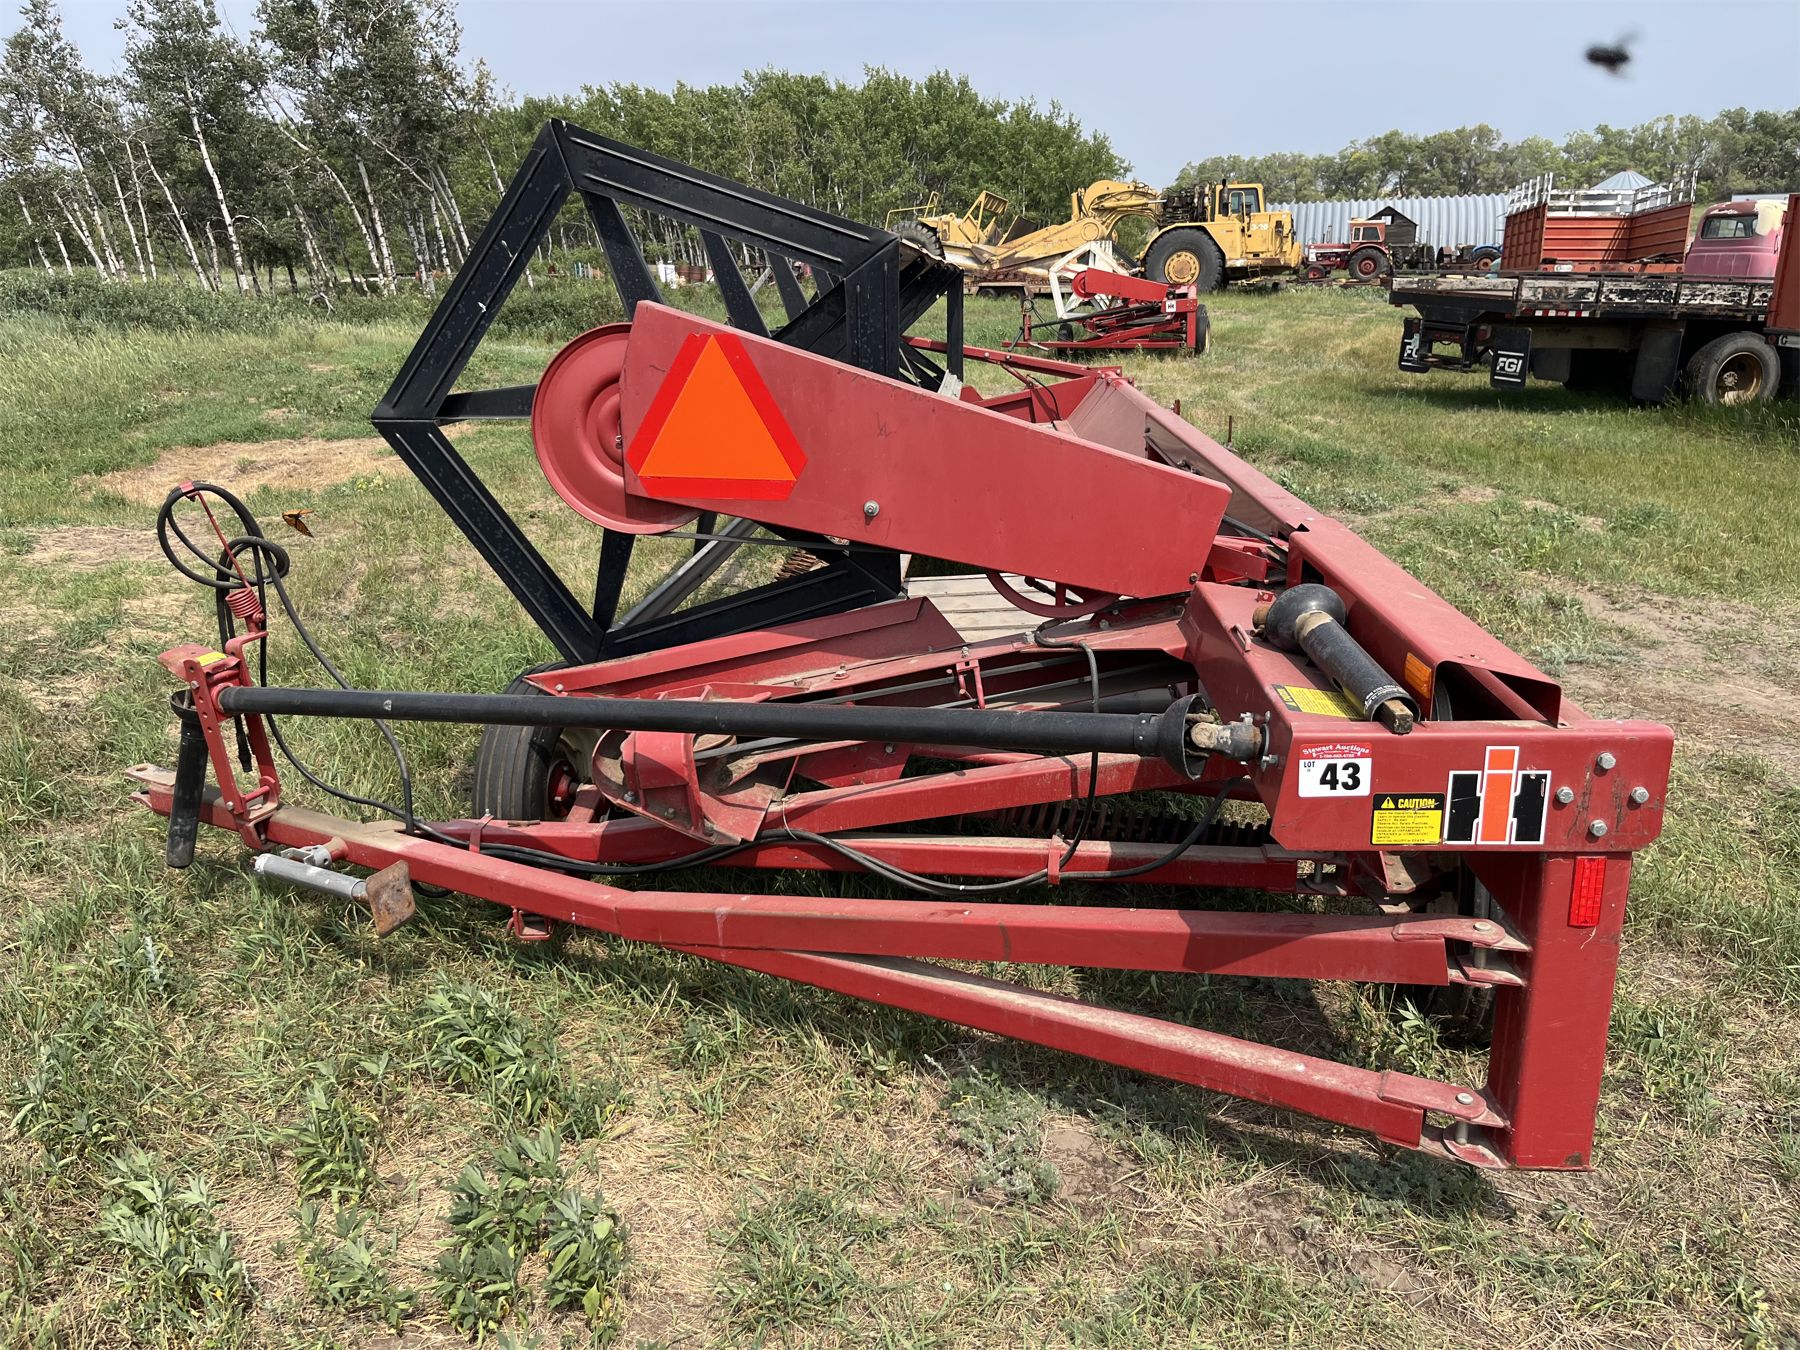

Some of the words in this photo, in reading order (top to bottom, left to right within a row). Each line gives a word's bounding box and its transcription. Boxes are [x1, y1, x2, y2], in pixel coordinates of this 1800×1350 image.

[1496, 357, 1522, 373] FGI
[1302, 744, 1334, 755] Stewart
[1335, 743, 1371, 754] Auctions
[1319, 762, 1361, 791] 43
[1397, 798, 1436, 809] CAUTION
